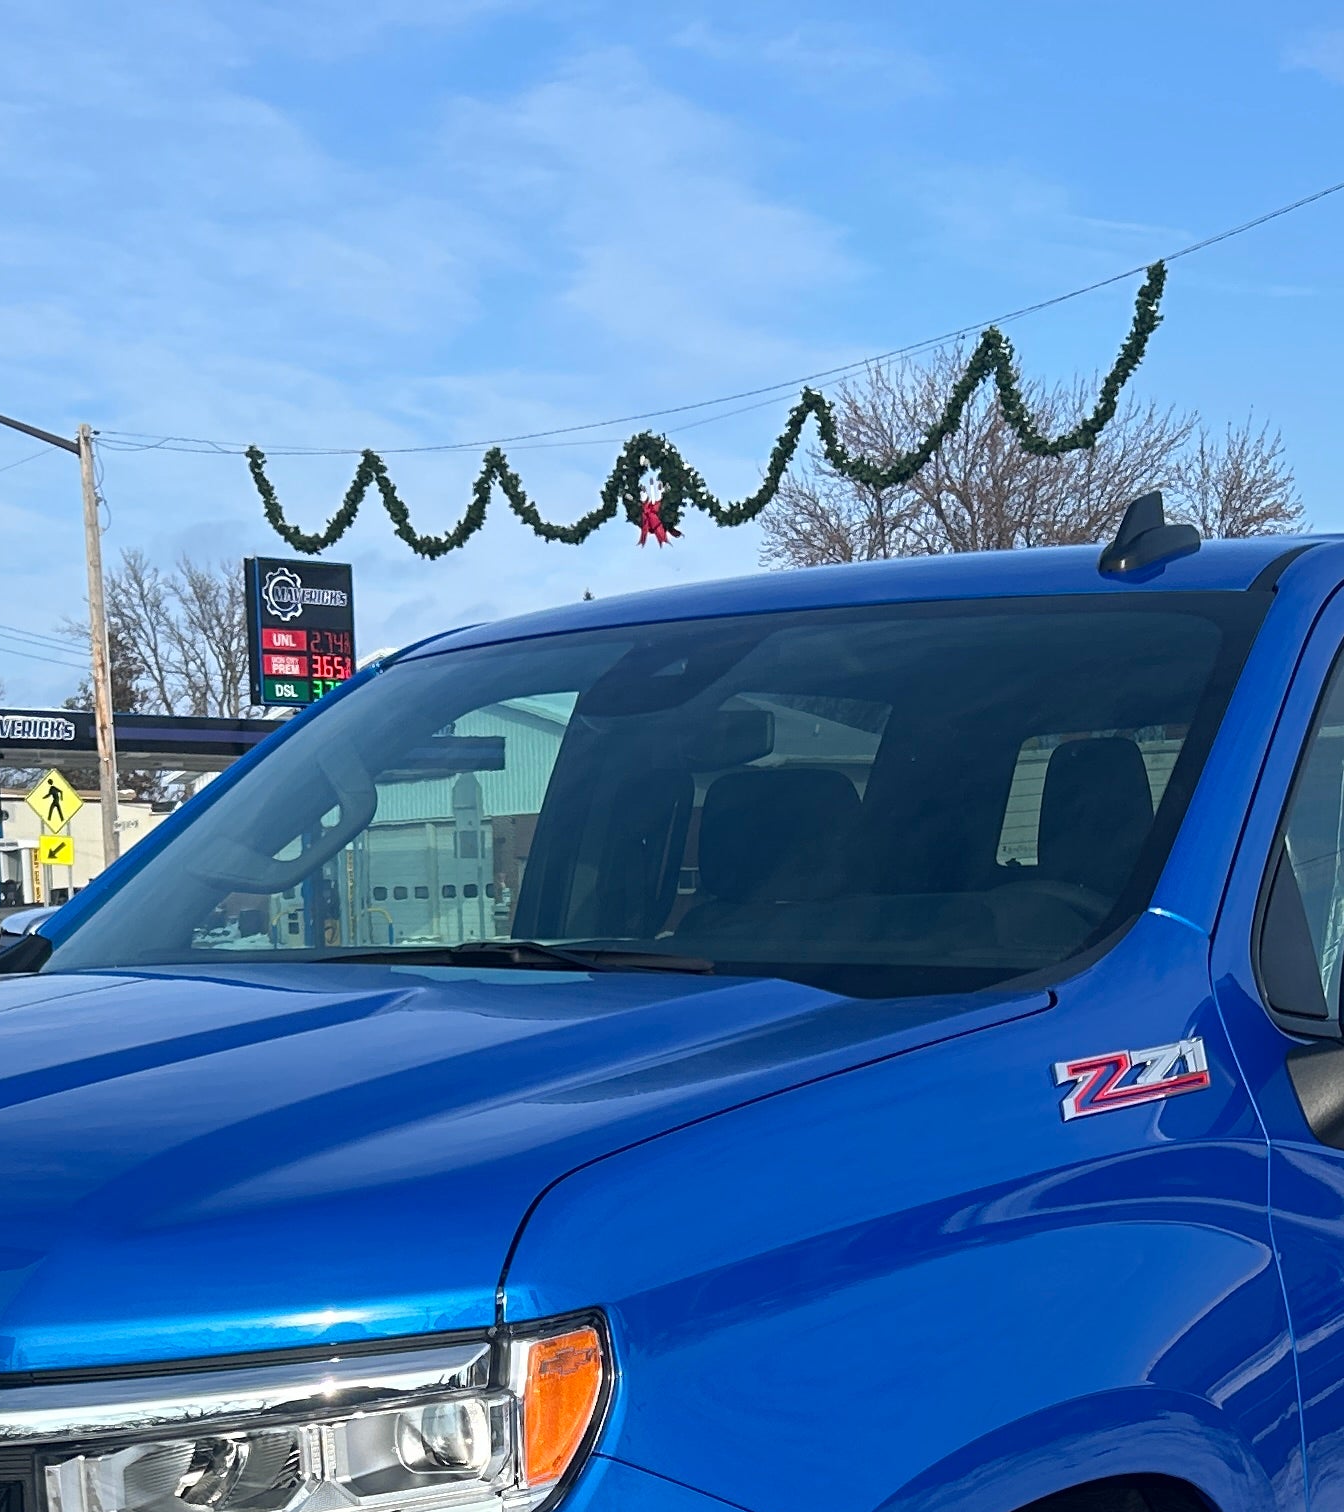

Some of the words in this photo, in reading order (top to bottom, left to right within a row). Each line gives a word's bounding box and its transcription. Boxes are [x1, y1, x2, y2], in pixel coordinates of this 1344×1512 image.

[272, 633, 297, 647] UNL
[272, 663, 301, 675] PREM
[275, 684, 299, 698] DSL
[1053, 1035, 1212, 1123] Z71
